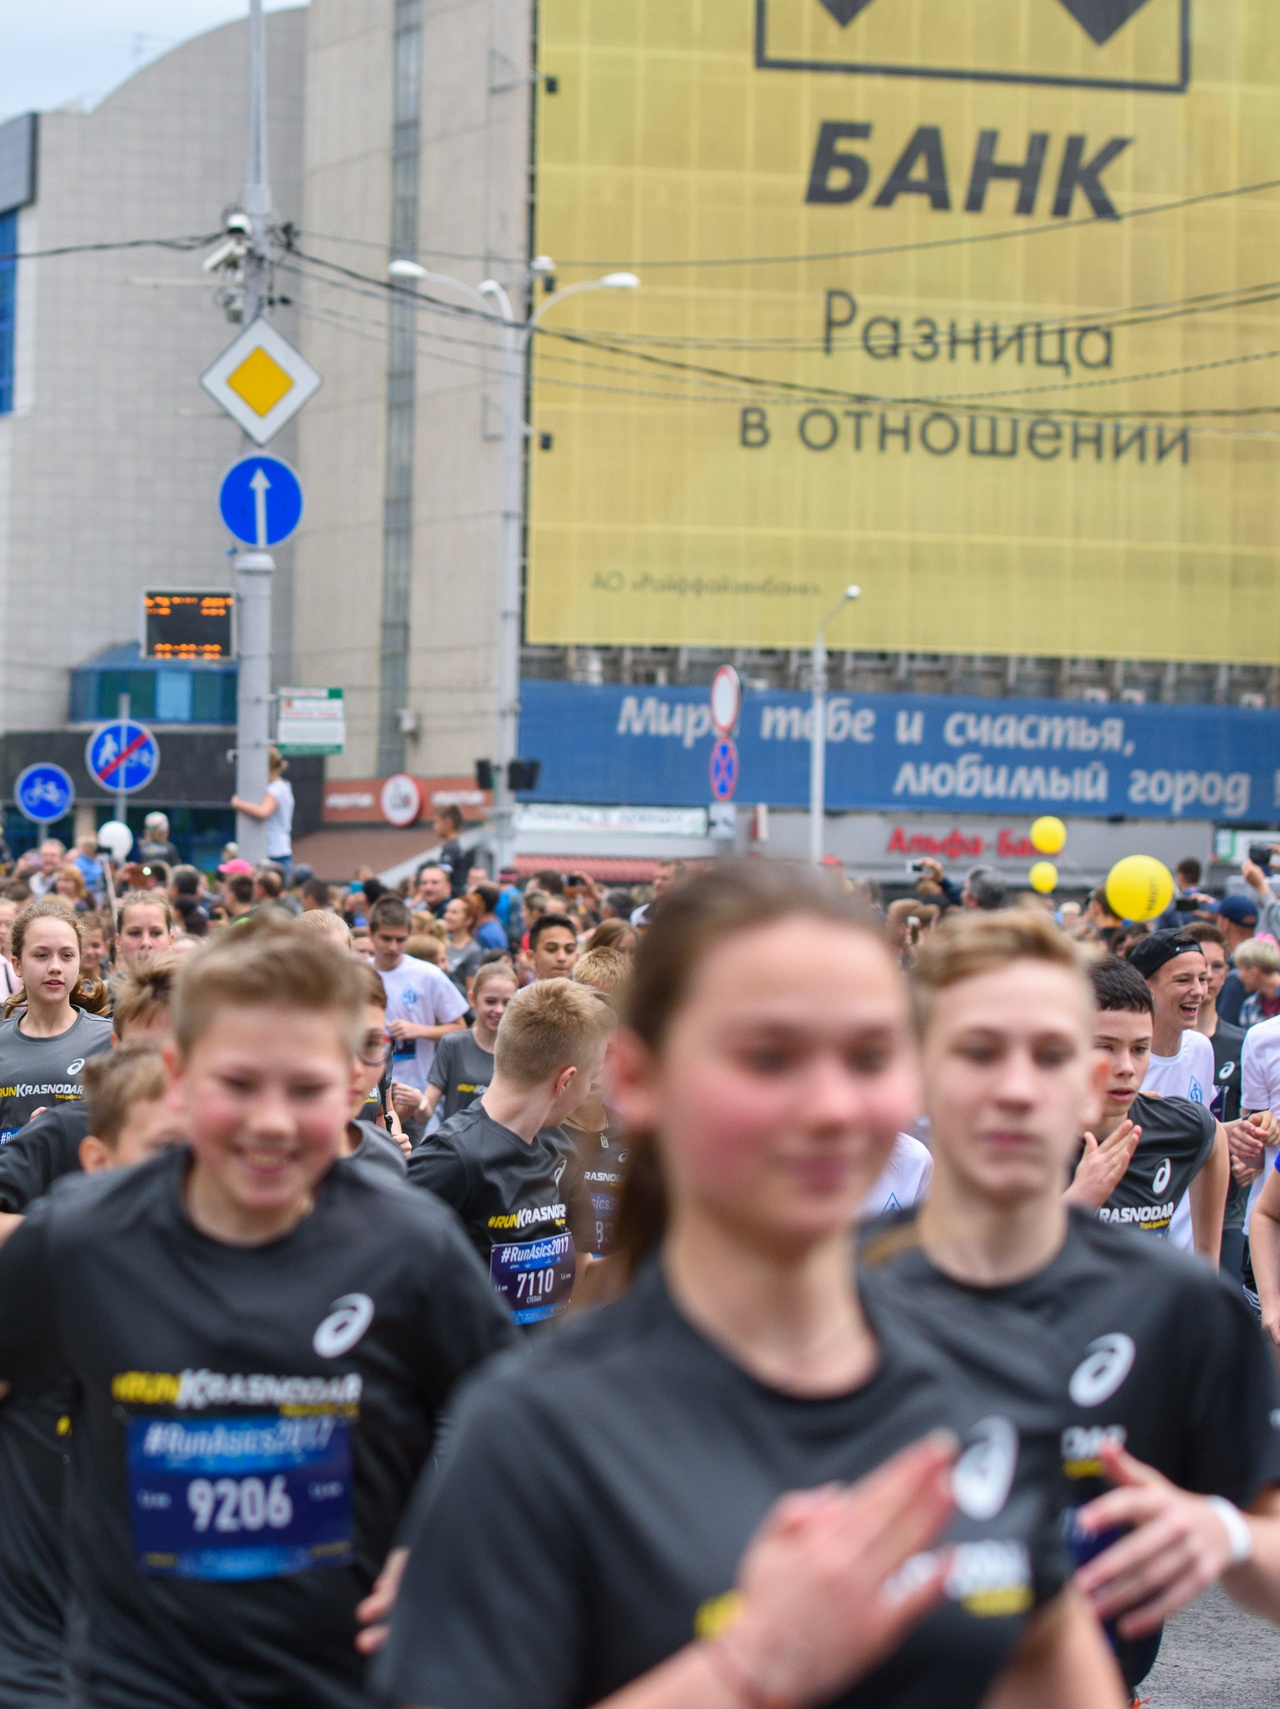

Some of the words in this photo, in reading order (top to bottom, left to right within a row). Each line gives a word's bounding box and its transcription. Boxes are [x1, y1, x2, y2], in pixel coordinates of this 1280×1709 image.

[805, 120, 1133, 221] БАНК
[824, 289, 1113, 377] Разница
[740, 407, 771, 449] в
[798, 407, 1190, 466] отношении
[617, 696, 740, 748] Мир
[895, 710, 924, 744] и
[943, 711, 1135, 757] счастья,
[892, 753, 1108, 802] любимый
[1128, 768, 1252, 817] город
[501, 1236, 569, 1263] #RunAsics2017
[517, 1268, 554, 1298] 7110
[186, 1474, 293, 1533] 9206
